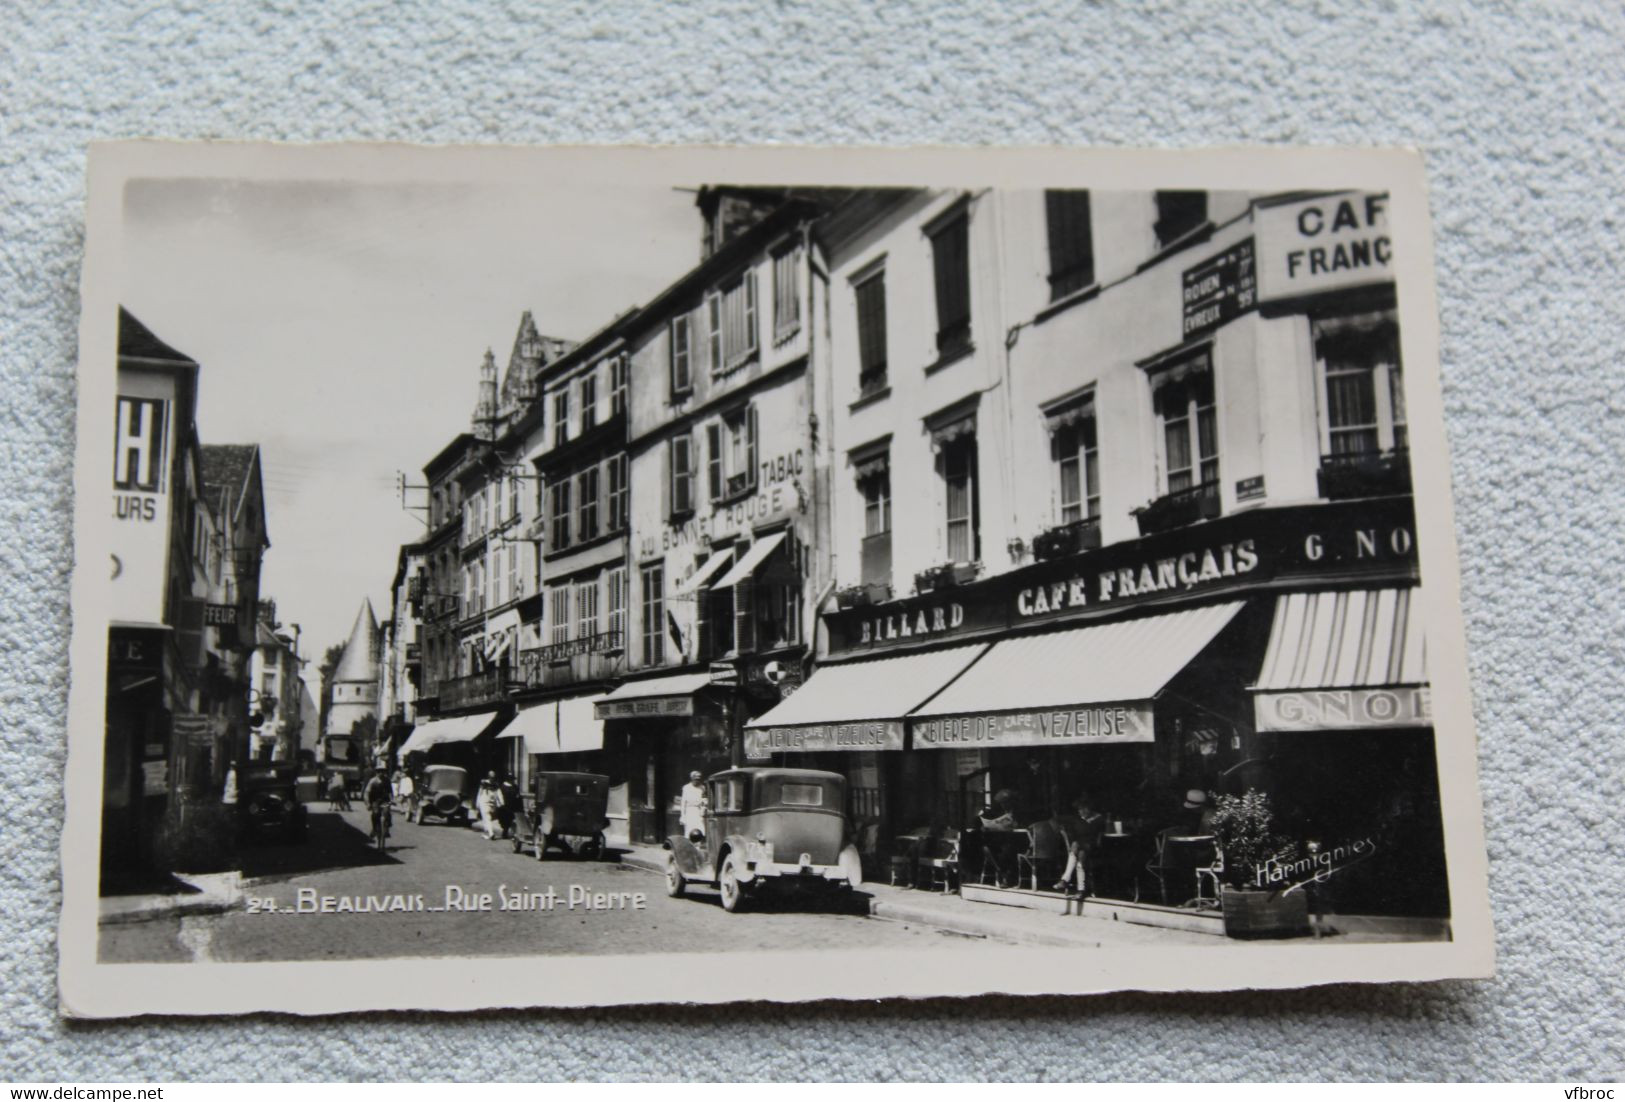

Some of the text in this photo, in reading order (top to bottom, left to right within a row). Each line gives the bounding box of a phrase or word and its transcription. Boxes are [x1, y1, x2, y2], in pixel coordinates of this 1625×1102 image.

[1296, 190, 1390, 237] CAF
[1287, 237, 1393, 279] FRANÇ
[1184, 273, 1220, 303] ROUEN
[1184, 304, 1220, 334] EVREUX
[761, 448, 803, 490] TABAC
[113, 495, 156, 521] URS
[725, 487, 783, 531] ROUGE
[860, 603, 963, 643] BILLARD
[1099, 539, 1259, 601] FRANÇAIS
[976, 716, 996, 741] DE
[1039, 707, 1126, 738] VEZELISE
